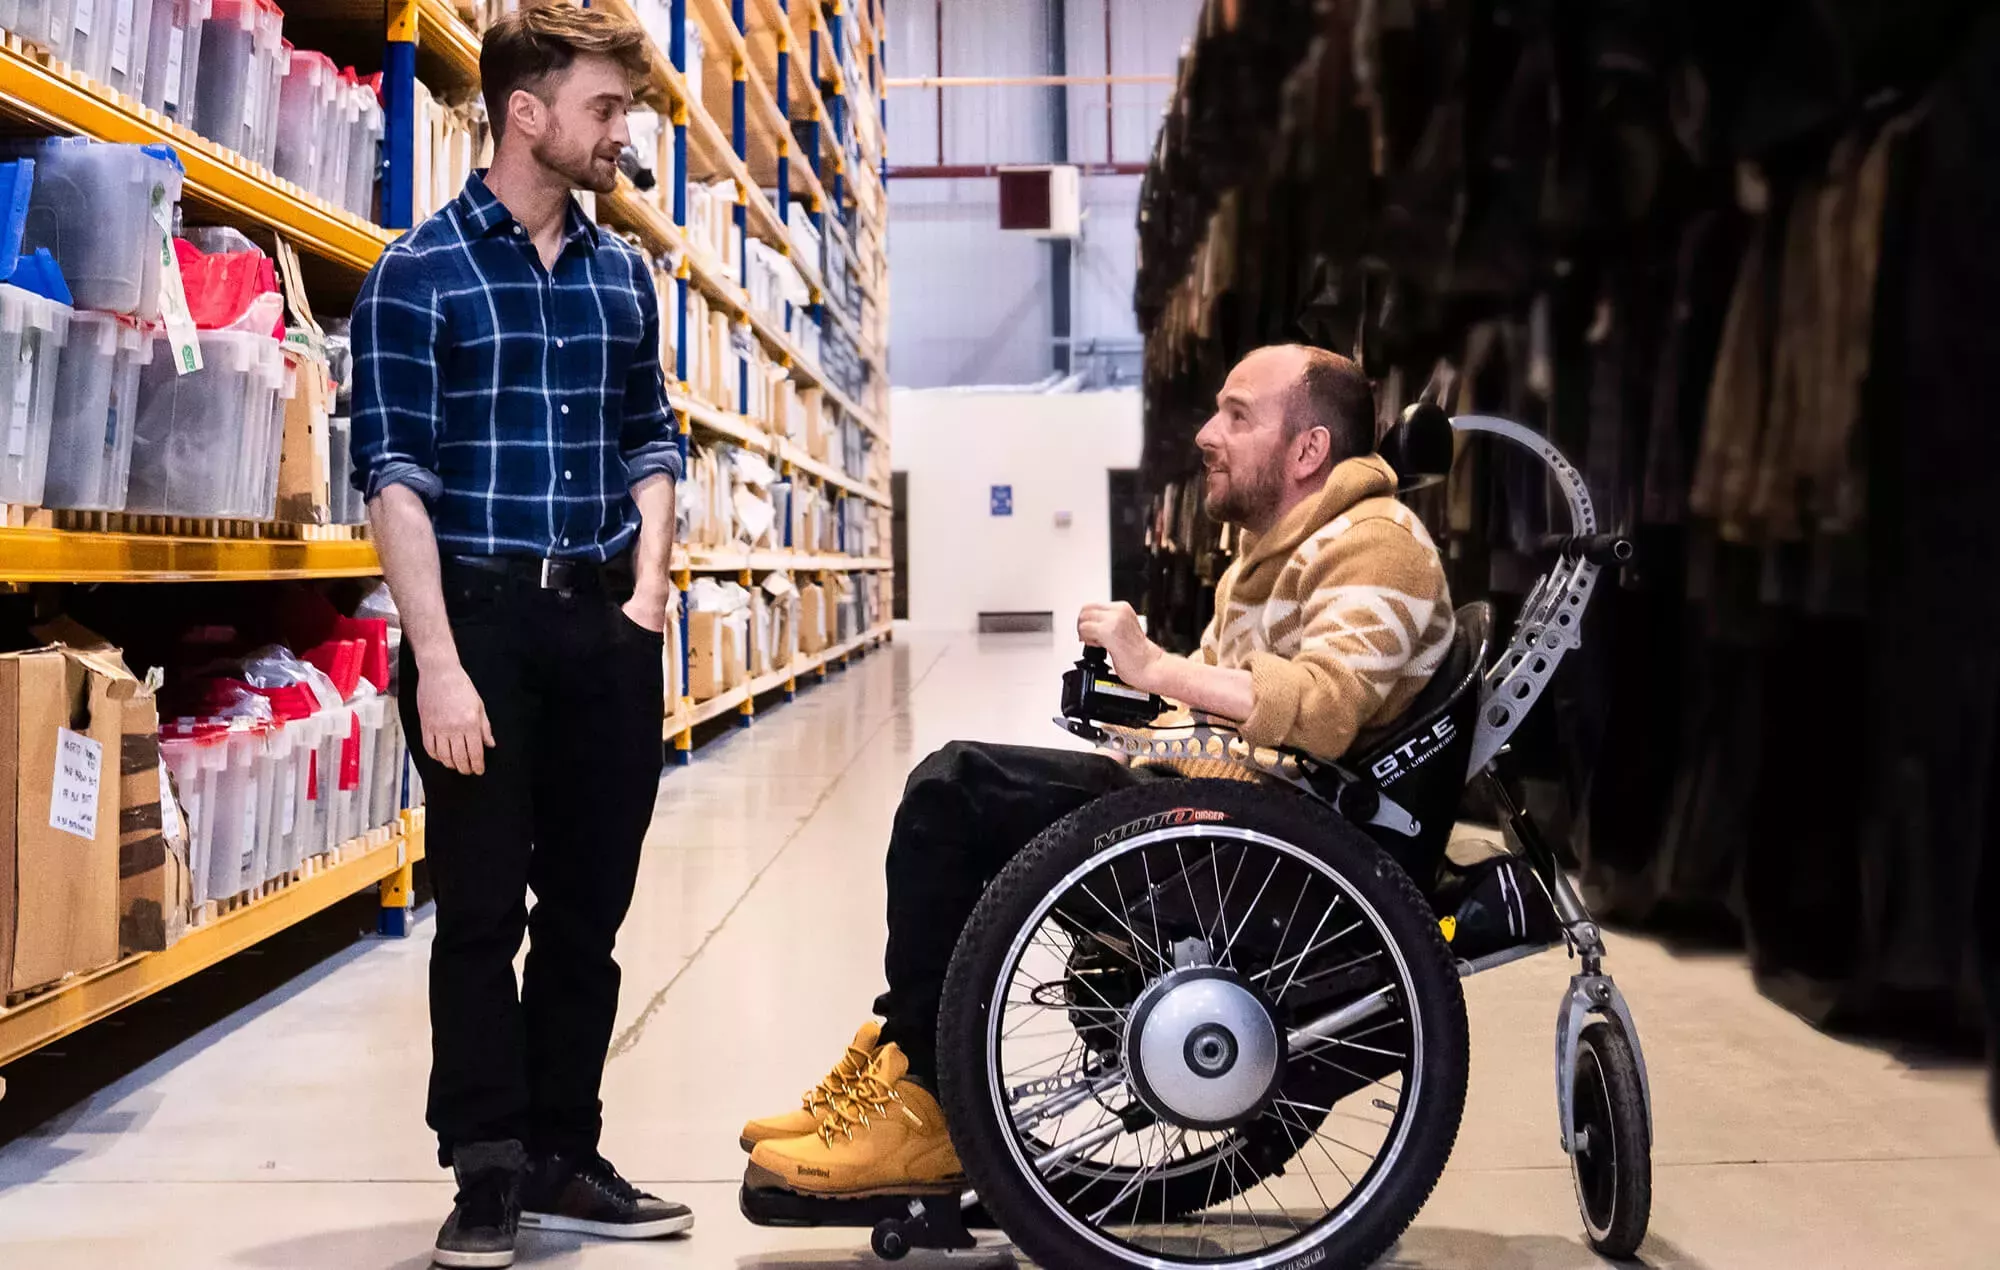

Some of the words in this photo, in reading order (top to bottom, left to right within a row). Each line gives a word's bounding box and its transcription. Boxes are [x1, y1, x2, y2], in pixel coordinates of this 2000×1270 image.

[1371, 714, 1455, 779] GT-E
[1380, 768, 1406, 788] ULTRA
[1194, 810, 1225, 821] DIGGER
